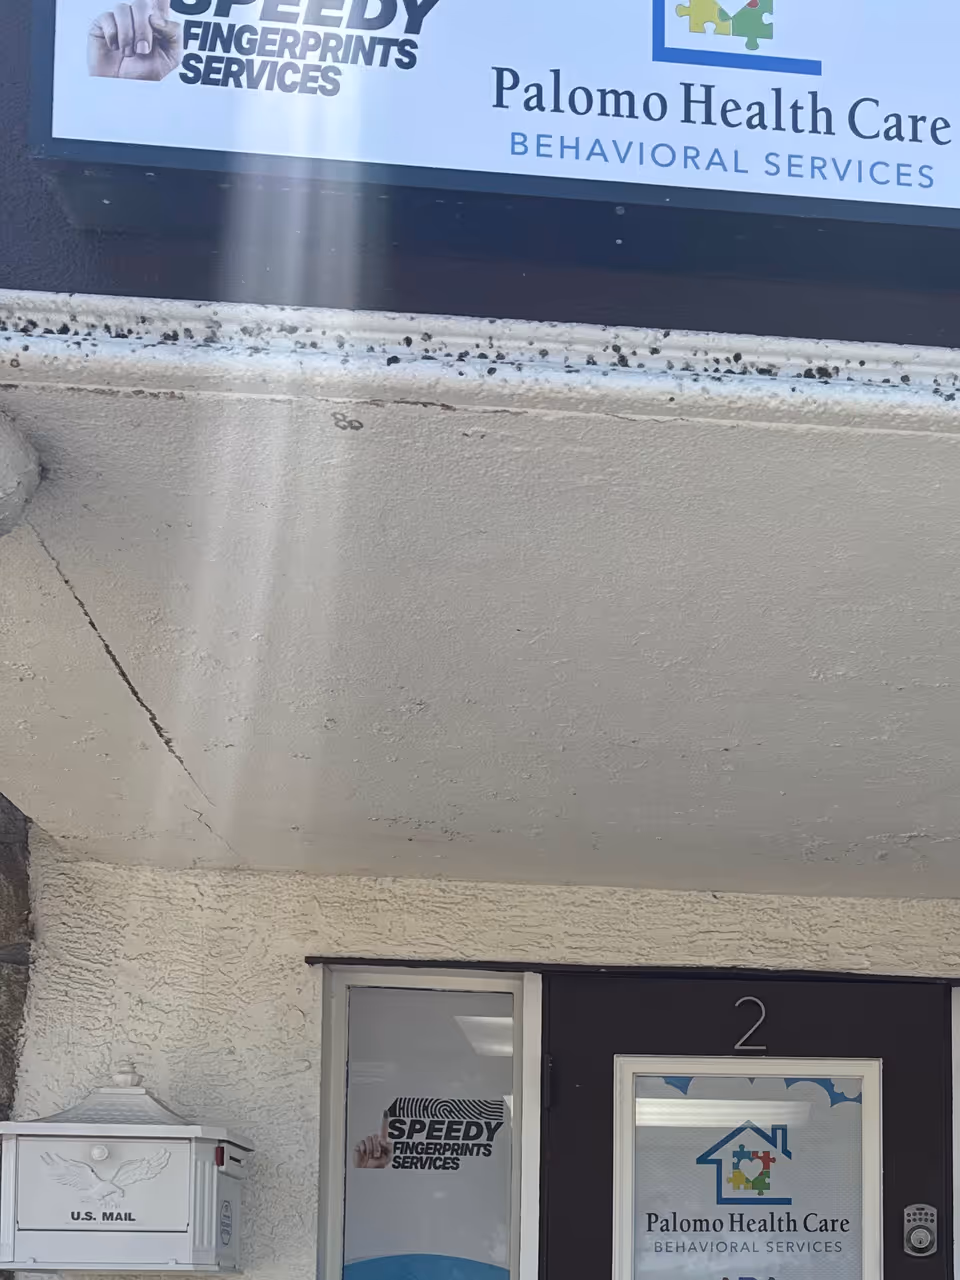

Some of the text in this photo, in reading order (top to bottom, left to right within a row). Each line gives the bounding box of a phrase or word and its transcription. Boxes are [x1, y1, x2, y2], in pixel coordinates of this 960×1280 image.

[183, 20, 418, 70] FINGERPRINTS
[178, 53, 342, 96] SERVICES
[491, 66, 952, 145] Palomo Health Care
[510, 131, 934, 189] BEHAVIORAL SERVICES
[734, 996, 766, 1049] 2
[388, 1119, 504, 1142] SPEEDY
[393, 1141, 492, 1157] FINGERPRINTS
[392, 1155, 460, 1170] SERVICES
[70, 1211, 136, 1221] U.S. MAIL
[645, 1212, 850, 1233] Palomo Health Care
[654, 1241, 842, 1253] BEHAVIORAL SERVICES
